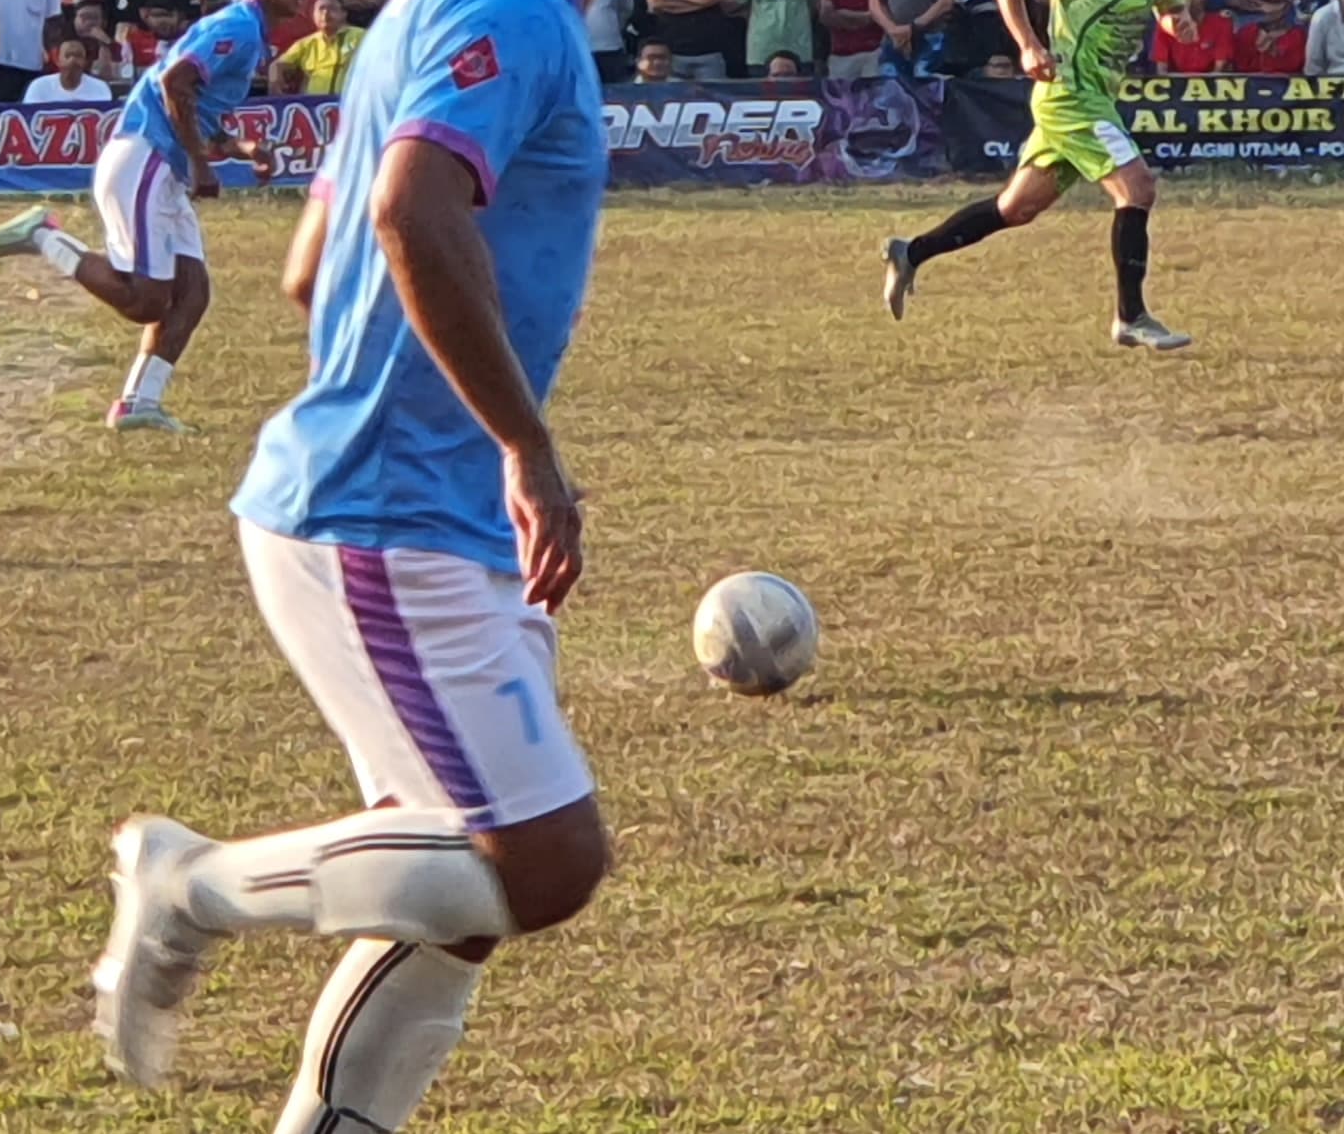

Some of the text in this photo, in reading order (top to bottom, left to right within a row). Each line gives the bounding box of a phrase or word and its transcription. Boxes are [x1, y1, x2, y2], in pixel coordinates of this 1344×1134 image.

[1181, 78, 1247, 102] AN
[1130, 109, 1187, 133] AL
[1198, 108, 1335, 133] KHOIR
[1157, 142, 1184, 158] CV.
[1239, 141, 1300, 157] UTAMA
